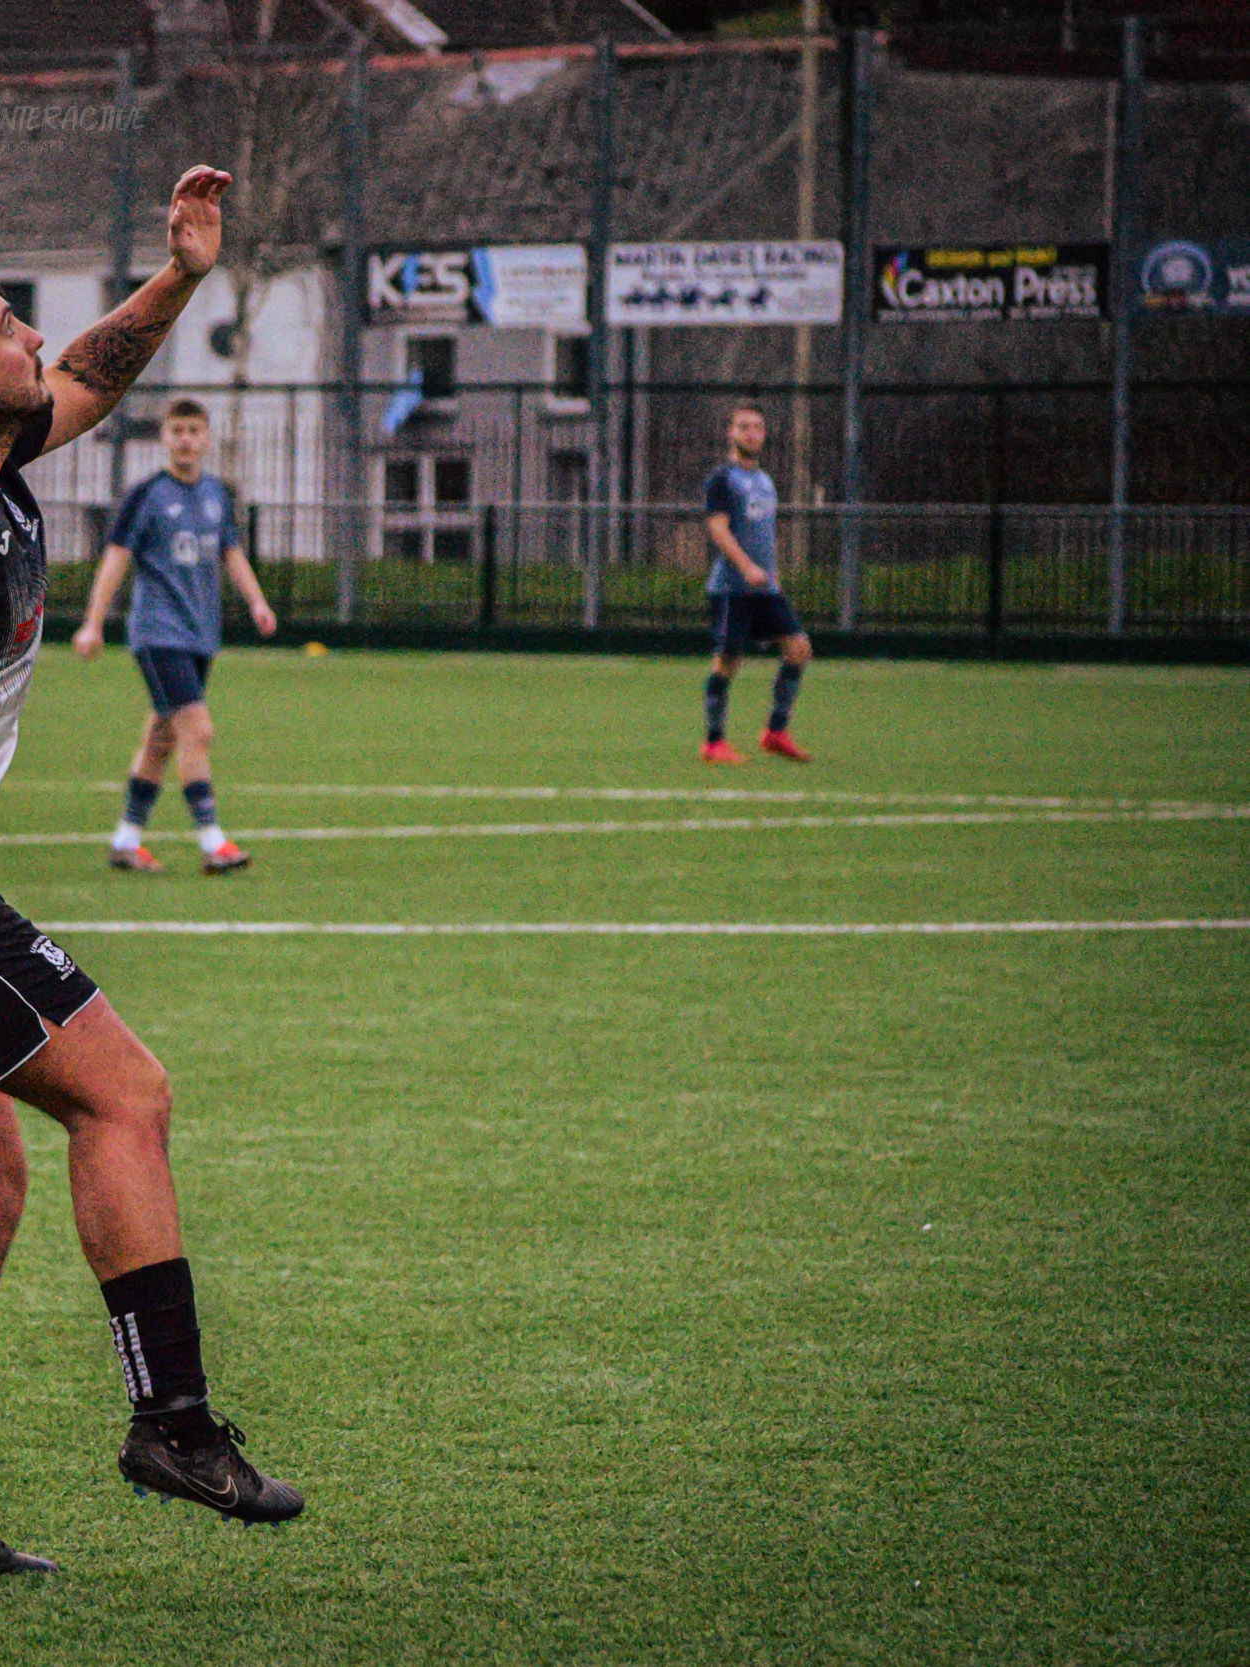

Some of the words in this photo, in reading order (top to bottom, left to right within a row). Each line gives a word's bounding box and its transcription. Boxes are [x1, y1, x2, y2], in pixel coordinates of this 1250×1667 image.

[368, 252, 468, 308] KES
[898, 268, 1004, 308] Caxton
[1014, 266, 1097, 304] Press
